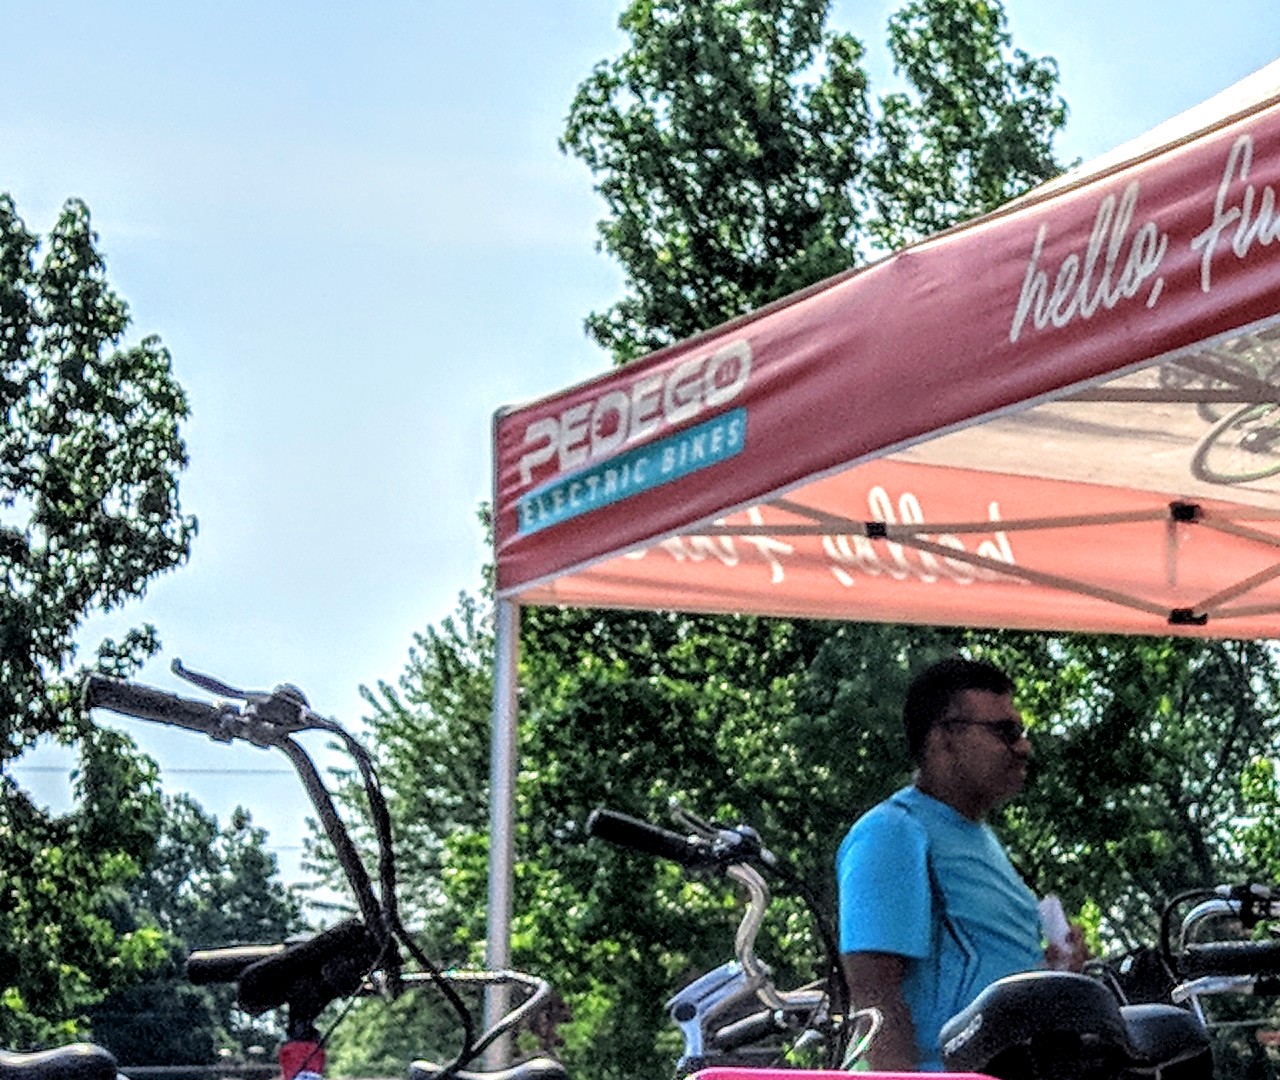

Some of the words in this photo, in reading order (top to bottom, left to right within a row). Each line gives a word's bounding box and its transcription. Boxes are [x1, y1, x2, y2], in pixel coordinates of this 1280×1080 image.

[1010, 180, 1168, 344] hello,
[518, 341, 753, 484] PEDEGO
[522, 461, 646, 527] ELECTRIC
[661, 417, 743, 472] BIKES
